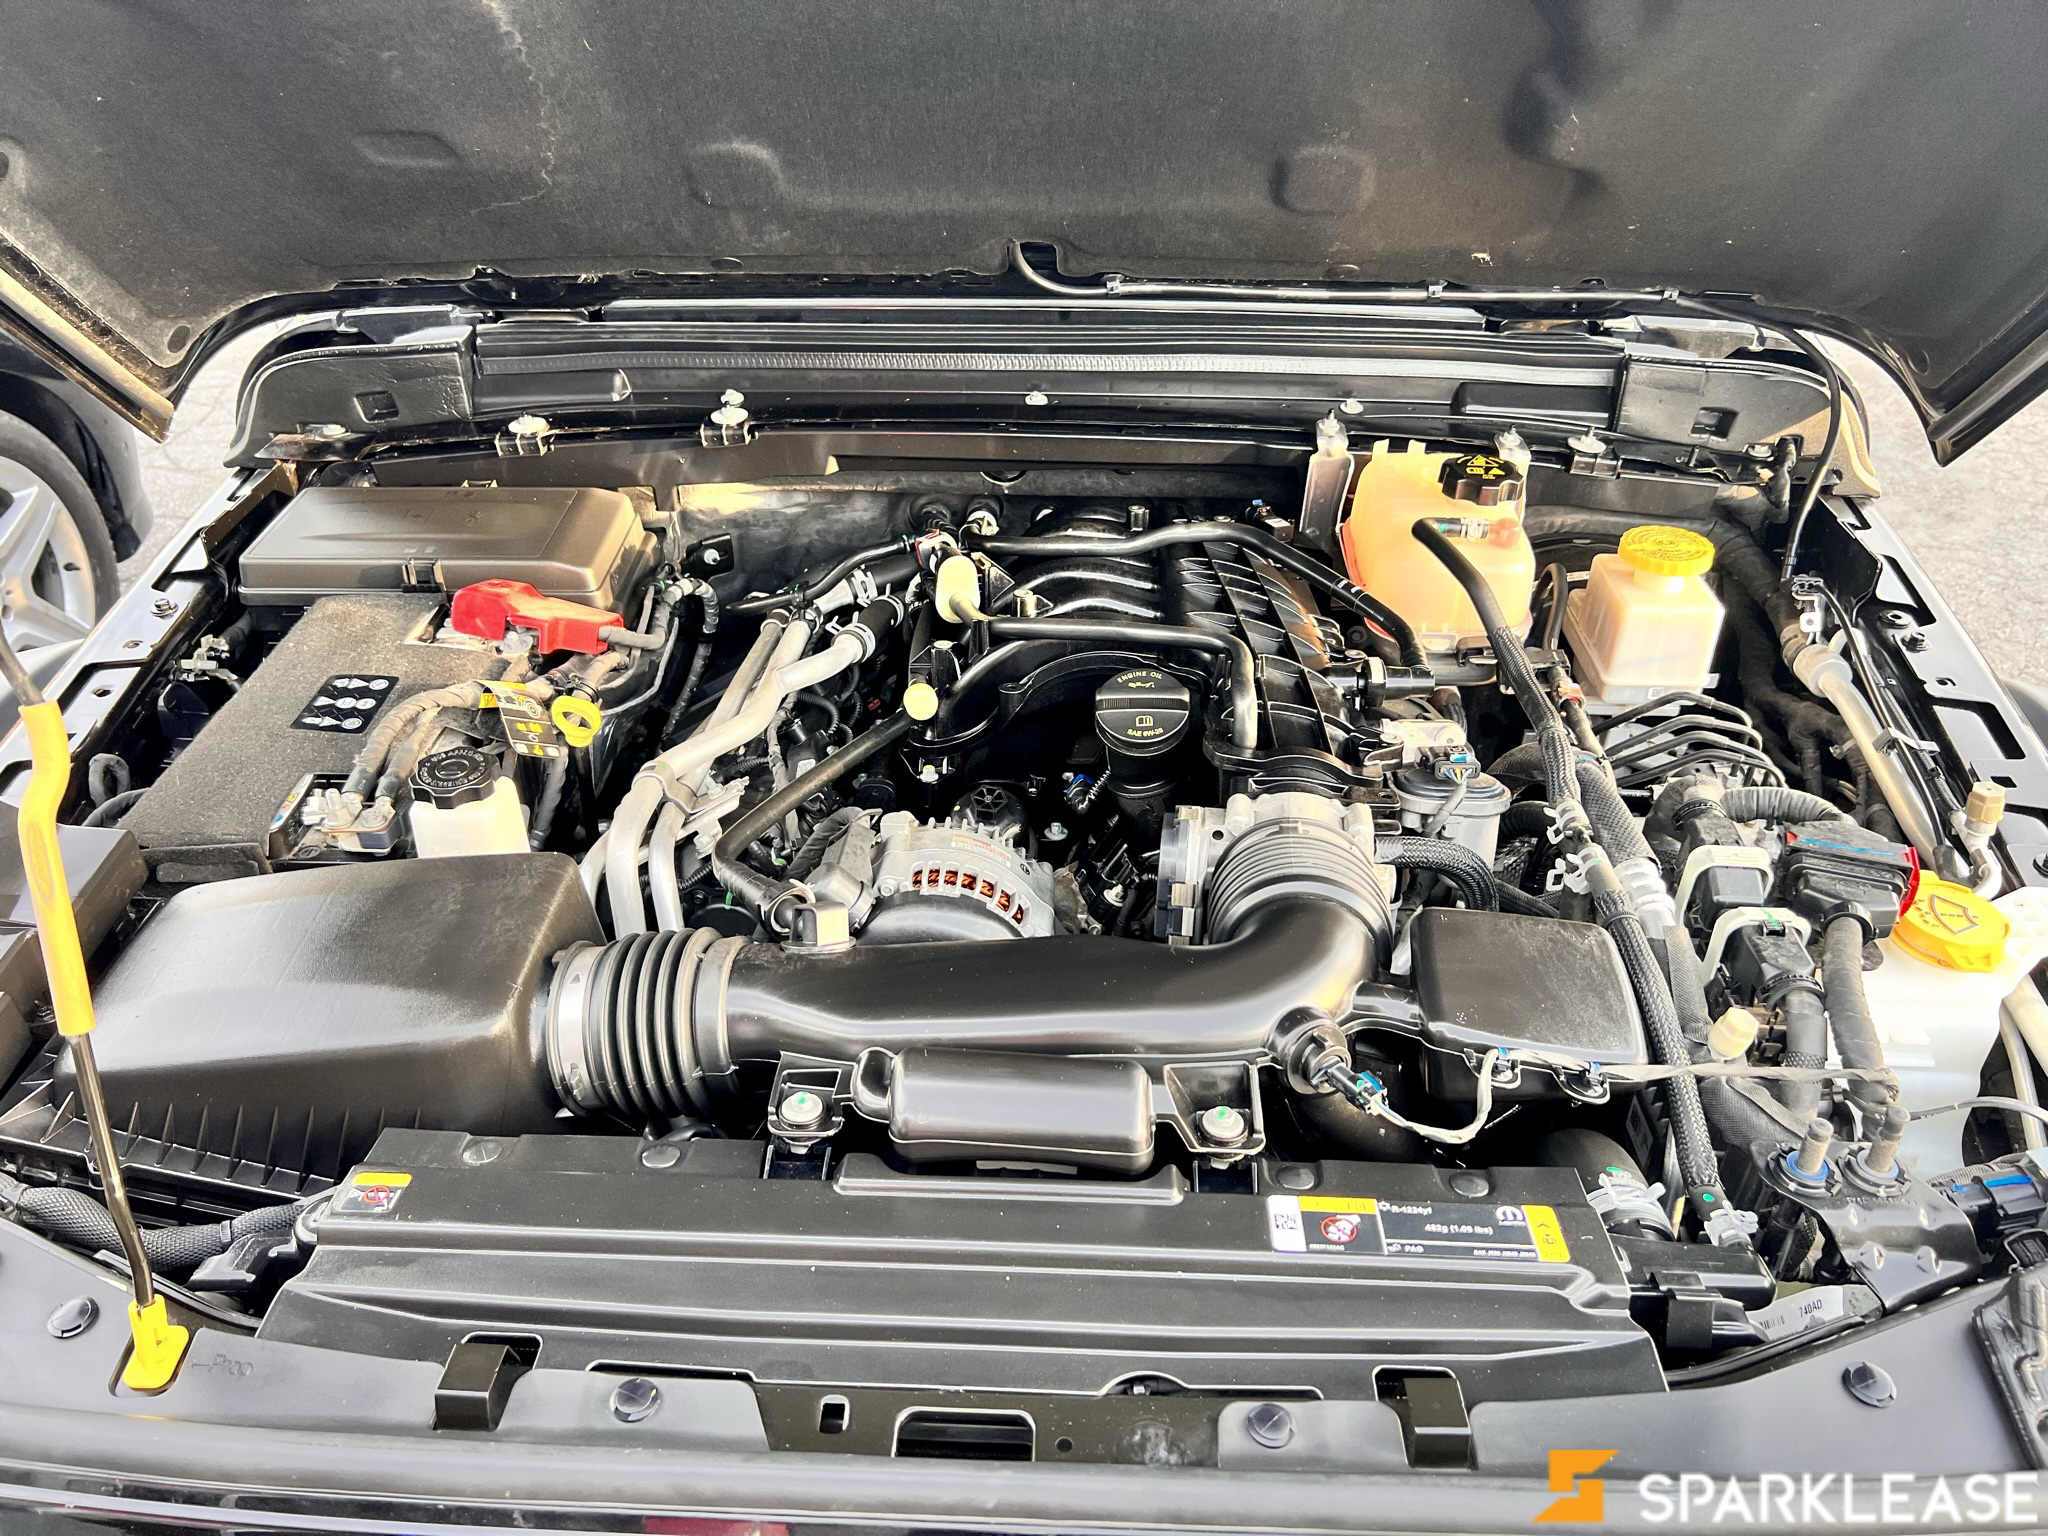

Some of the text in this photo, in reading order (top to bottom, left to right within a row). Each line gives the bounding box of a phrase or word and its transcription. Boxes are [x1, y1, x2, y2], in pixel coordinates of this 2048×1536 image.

[1117, 671, 1163, 683] ENGINE OIL
[1127, 728, 1142, 737] SAE
